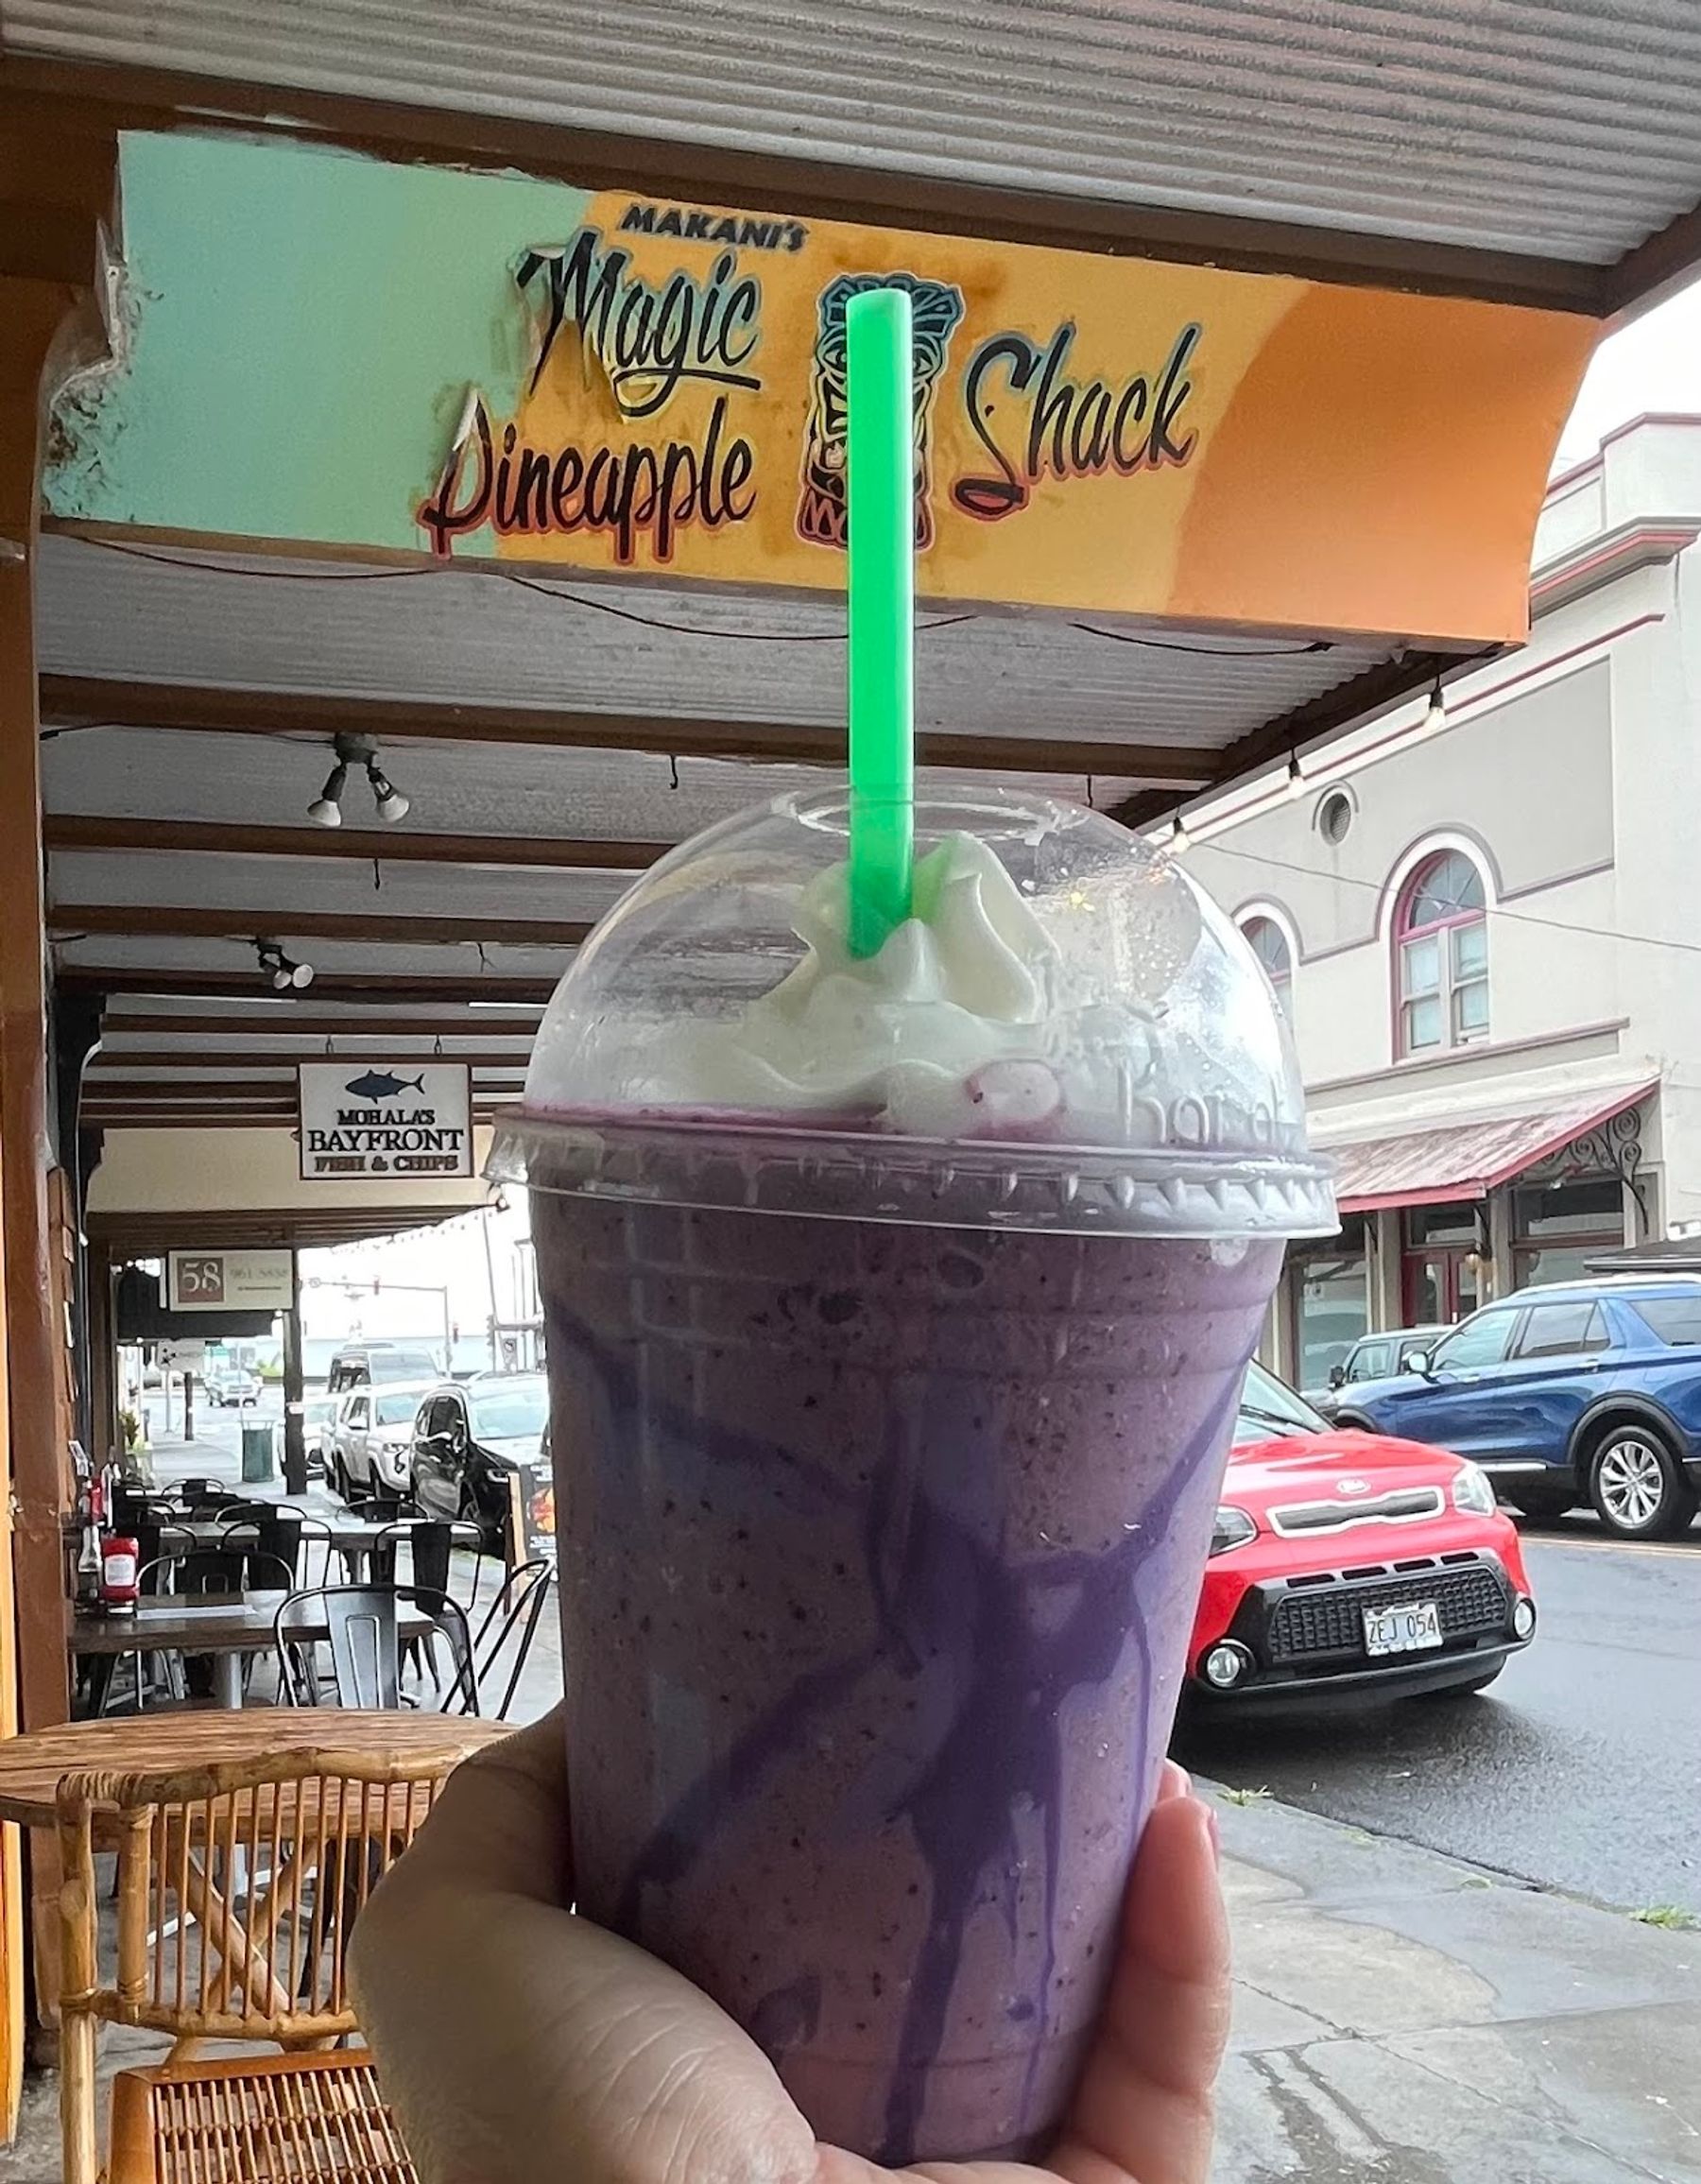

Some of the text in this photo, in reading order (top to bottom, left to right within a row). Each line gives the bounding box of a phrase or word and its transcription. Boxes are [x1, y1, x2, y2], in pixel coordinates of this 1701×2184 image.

[621, 204, 808, 252] MAKANI'S
[516, 231, 762, 418] Magic
[952, 321, 1202, 522] Shack
[423, 387, 758, 559] Pineapple
[307, 1128, 465, 1152] BAYFRONT
[393, 1155, 459, 1172] CHIPS
[181, 1261, 222, 1294] 58
